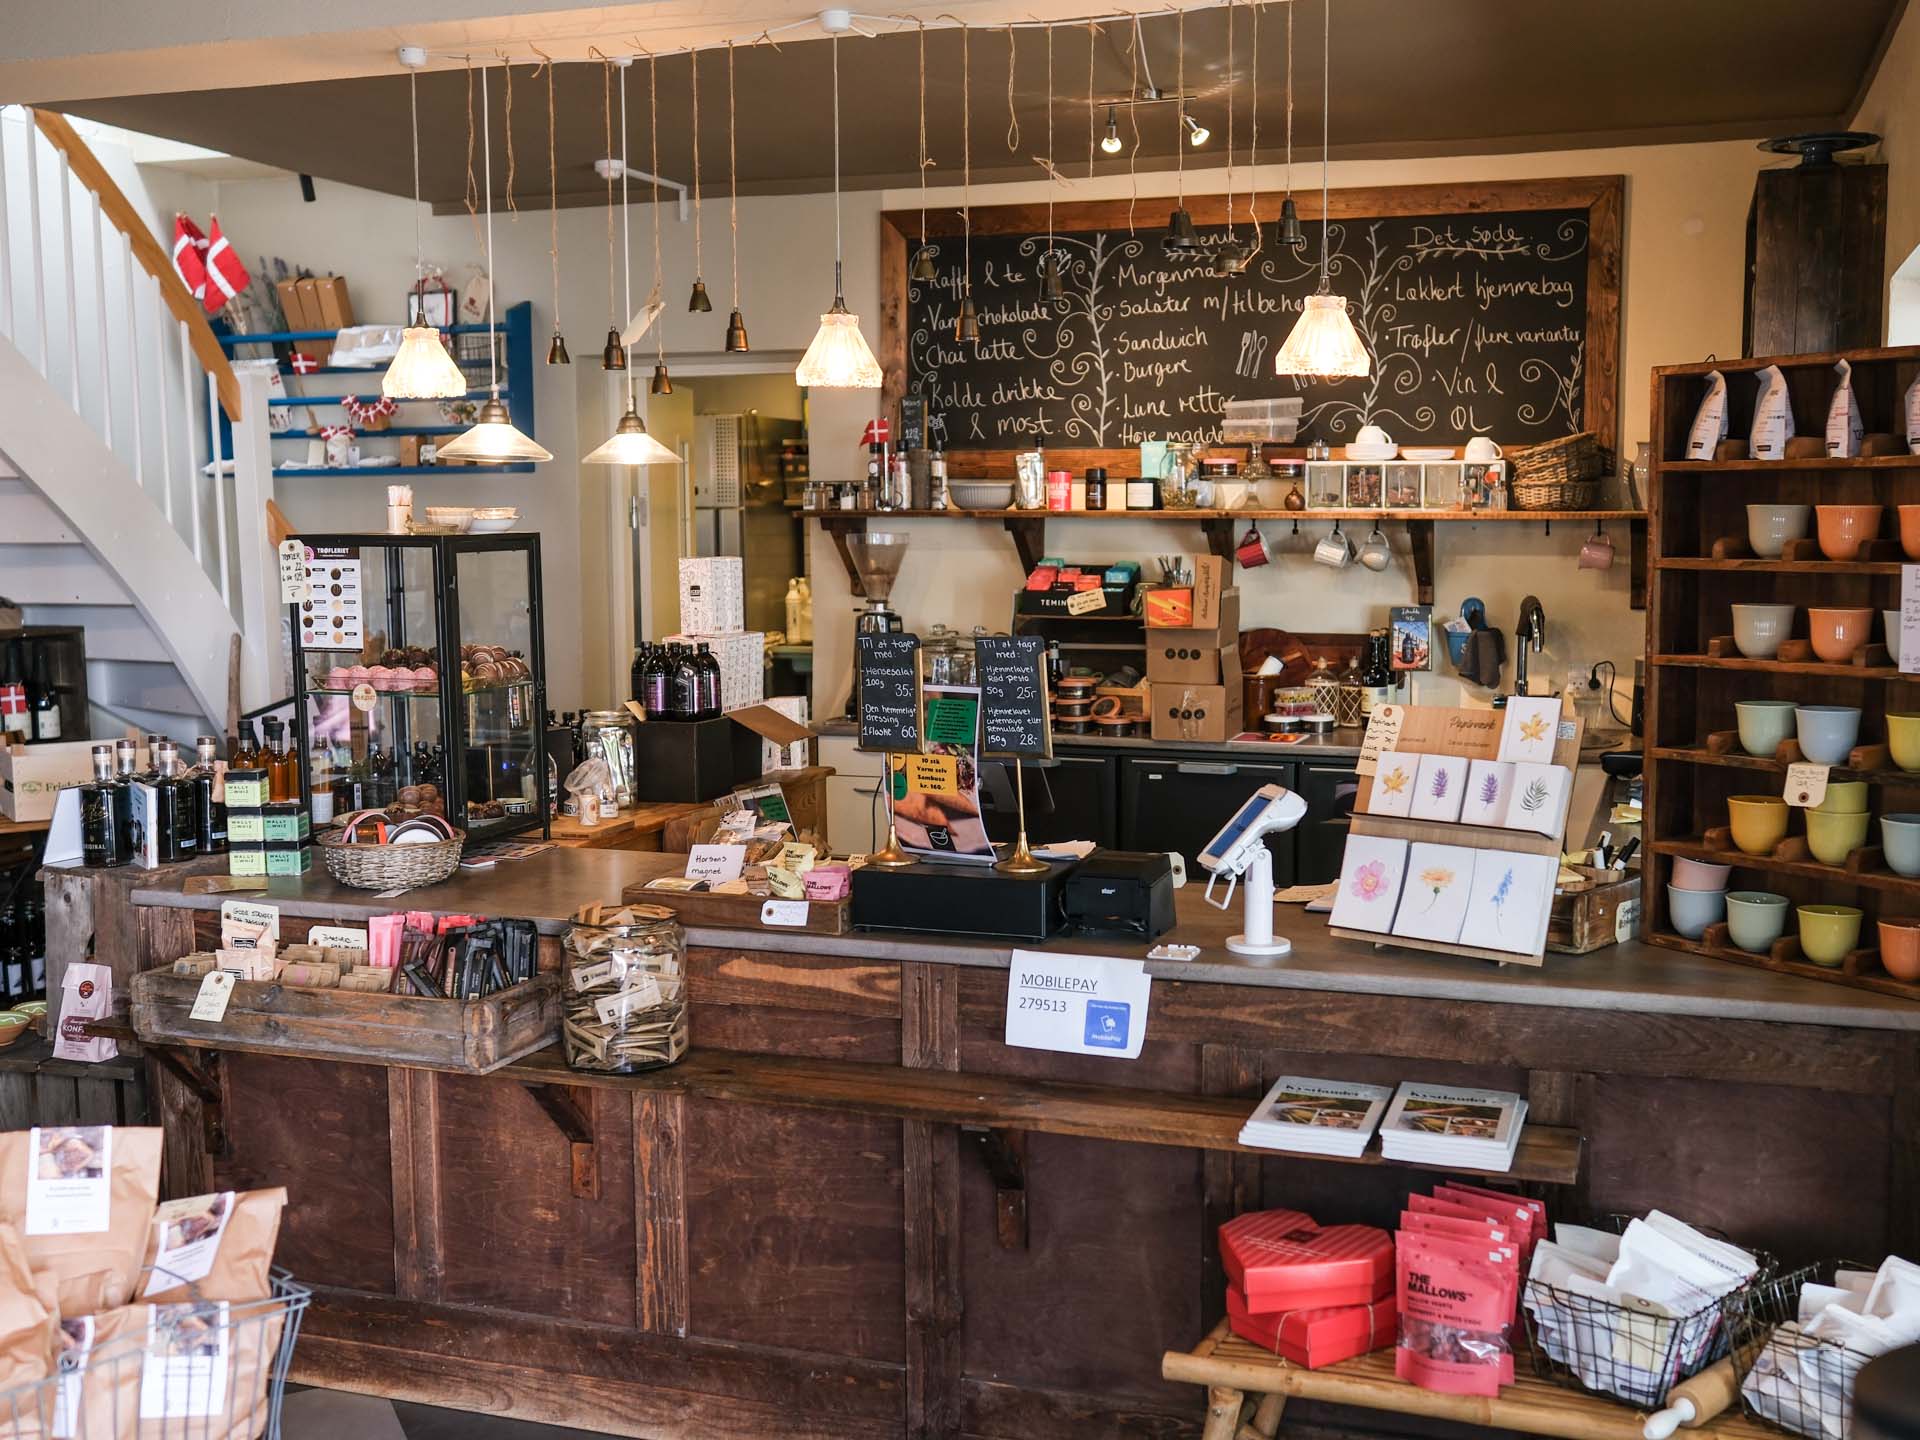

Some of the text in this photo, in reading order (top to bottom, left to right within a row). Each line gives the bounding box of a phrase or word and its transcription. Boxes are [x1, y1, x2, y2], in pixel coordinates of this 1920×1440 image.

[1411, 225, 1453, 247] Det
[1003, 263, 1026, 284] te
[1119, 264, 1236, 297] Morgenma
[1476, 271, 1573, 310] hjemmebag
[977, 299, 1054, 326] chokolade
[1119, 294, 1191, 318] Salater
[1117, 327, 1208, 354] Sandwich
[1388, 323, 1461, 358] Trøfler
[1475, 324, 1513, 352] flere
[1516, 325, 1580, 345] varianter
[926, 338, 1024, 365] Chai latte
[1123, 358, 1192, 387] Burgere
[1437, 365, 1477, 397] Vin
[932, 384, 986, 409] Kolde
[992, 378, 1065, 406] drikke
[1124, 385, 1235, 419] Lune retter
[1451, 405, 1493, 431] ØL
[1167, 425, 1225, 445] madde
[858, 637, 914, 653] Til at tage
[976, 639, 995, 649] Til
[1017, 641, 1037, 652] tage
[985, 665, 1034, 676] Hjemmelavet
[1006, 675, 1029, 684] pesto
[865, 678, 885, 689] 100g
[986, 686, 1004, 698] 50g
[865, 703, 879, 714] Den
[987, 706, 1031, 717] Hjemmelavet
[866, 714, 900, 728] dressing
[988, 735, 1007, 747] 150g
[695, 855, 727, 863] Horsens
[691, 867, 722, 875] magnet
[1020, 973, 1098, 991] MOBILEPAY
[1019, 996, 1067, 1012] 279513
[1408, 1271, 1430, 1284] THE
